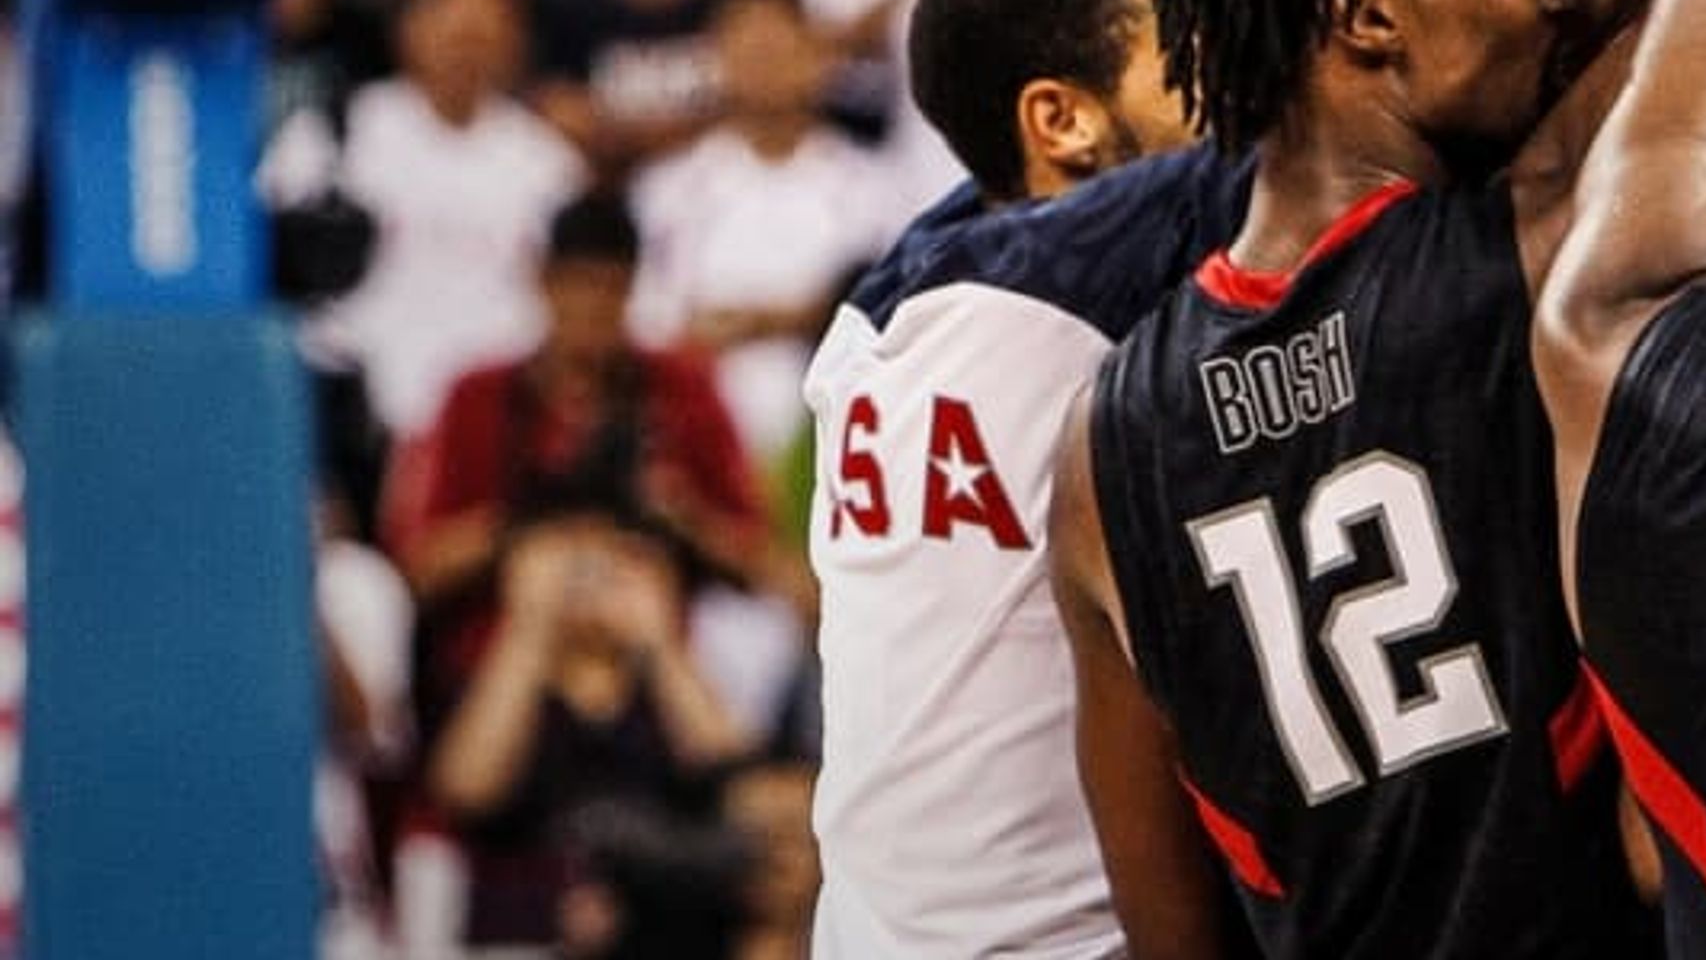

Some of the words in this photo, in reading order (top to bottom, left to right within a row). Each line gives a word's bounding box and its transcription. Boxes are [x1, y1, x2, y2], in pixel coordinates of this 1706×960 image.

[1200, 309, 1357, 453] BOSH
[830, 393, 1034, 552] SA
[1184, 448, 1511, 807] 12
